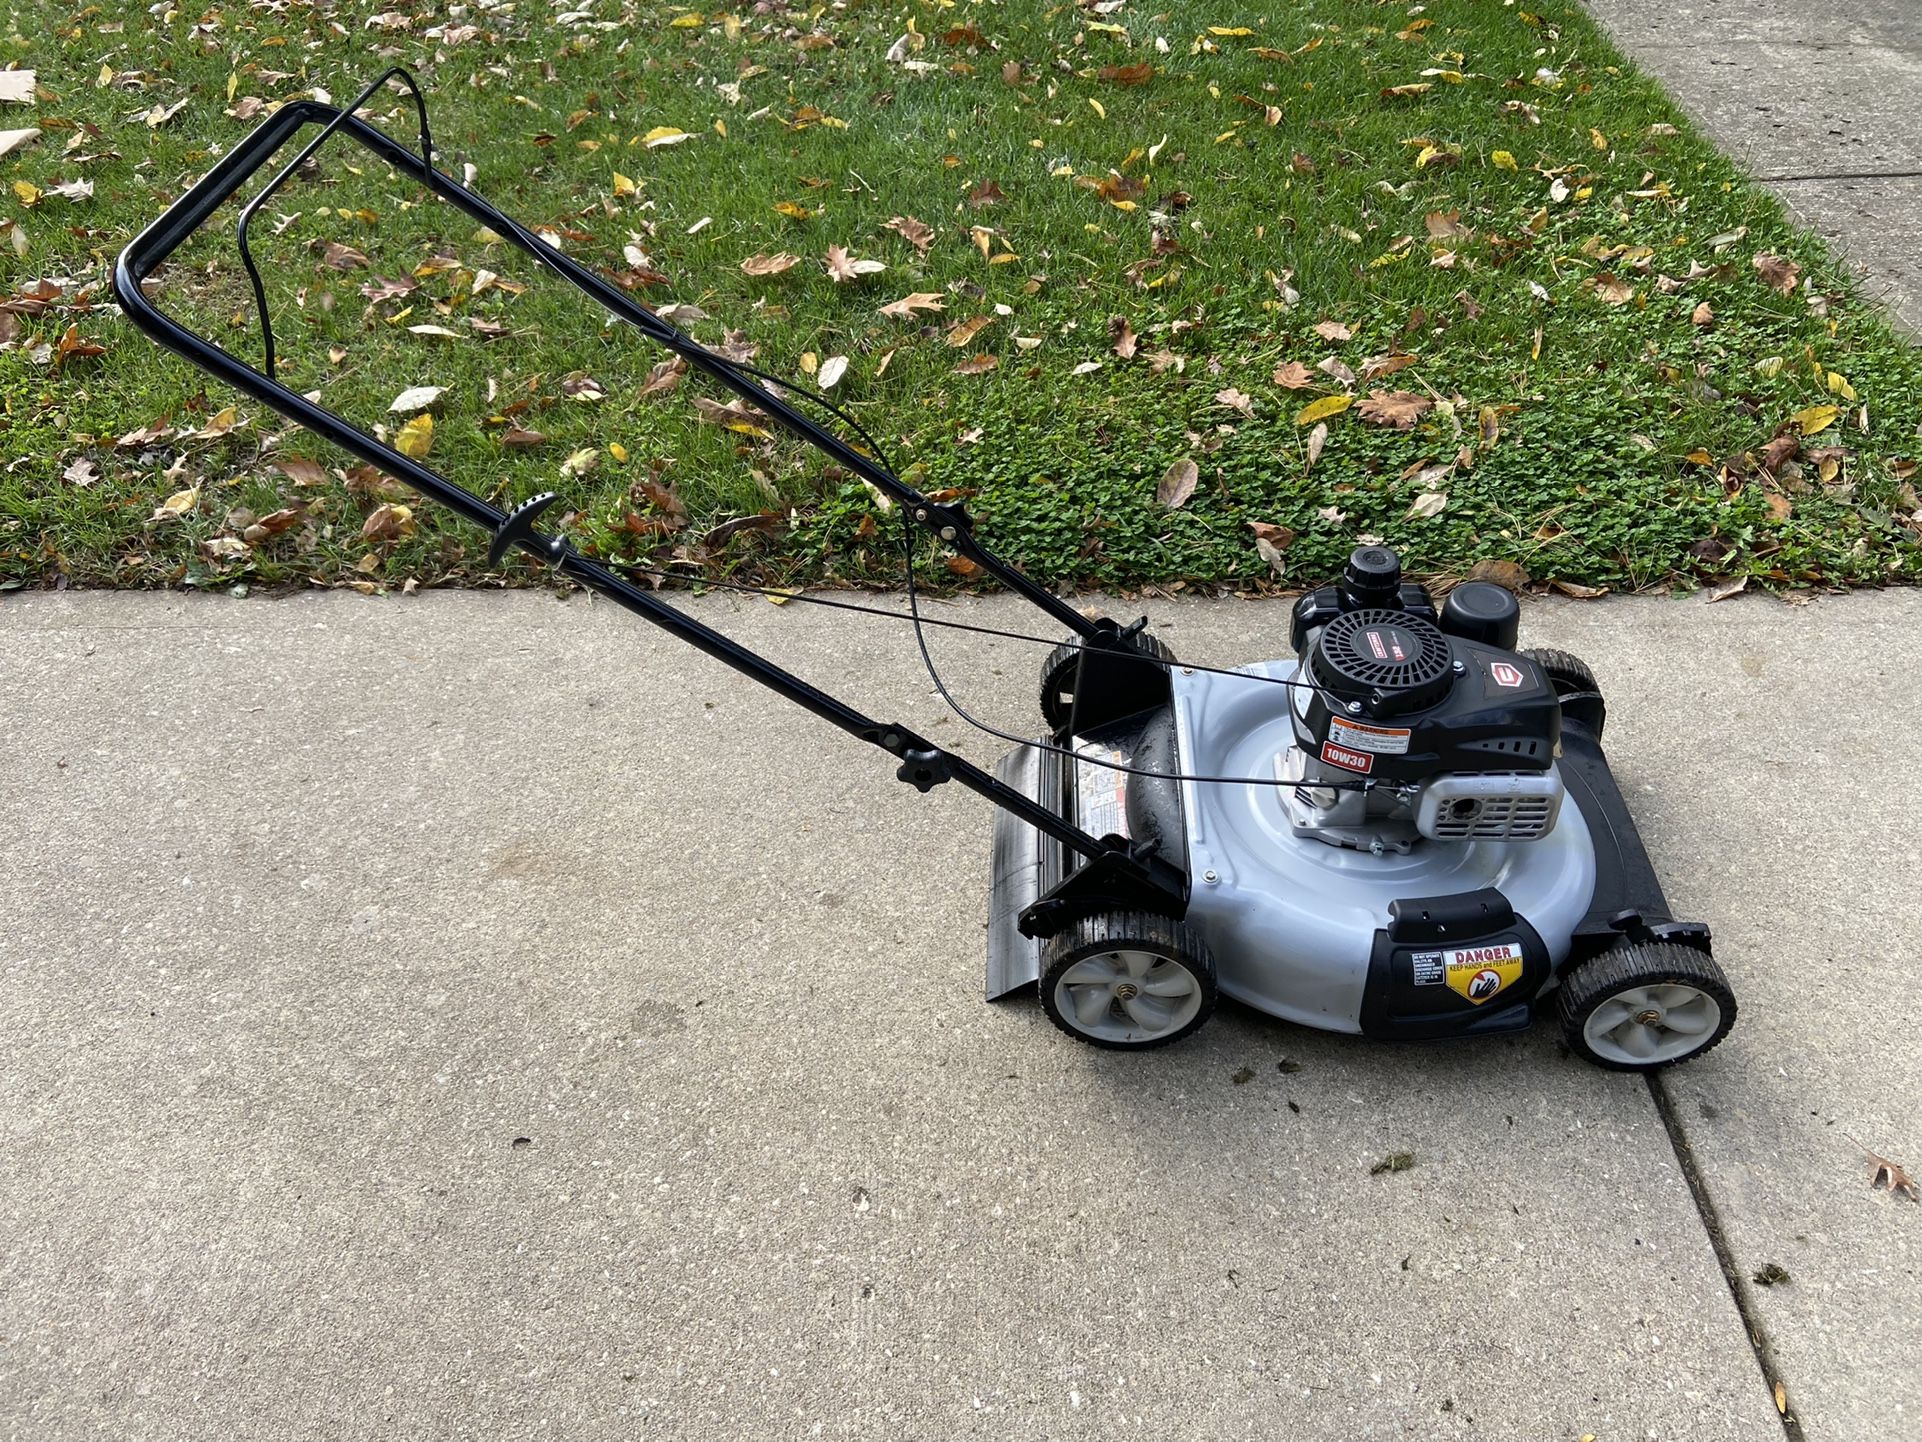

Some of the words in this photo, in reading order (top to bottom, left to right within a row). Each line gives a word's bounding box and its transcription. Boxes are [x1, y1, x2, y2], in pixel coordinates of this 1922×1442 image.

[1327, 747, 1366, 768] 10W30
[1455, 946, 1512, 964] DANGER
[1464, 962, 1482, 970] HANDS
